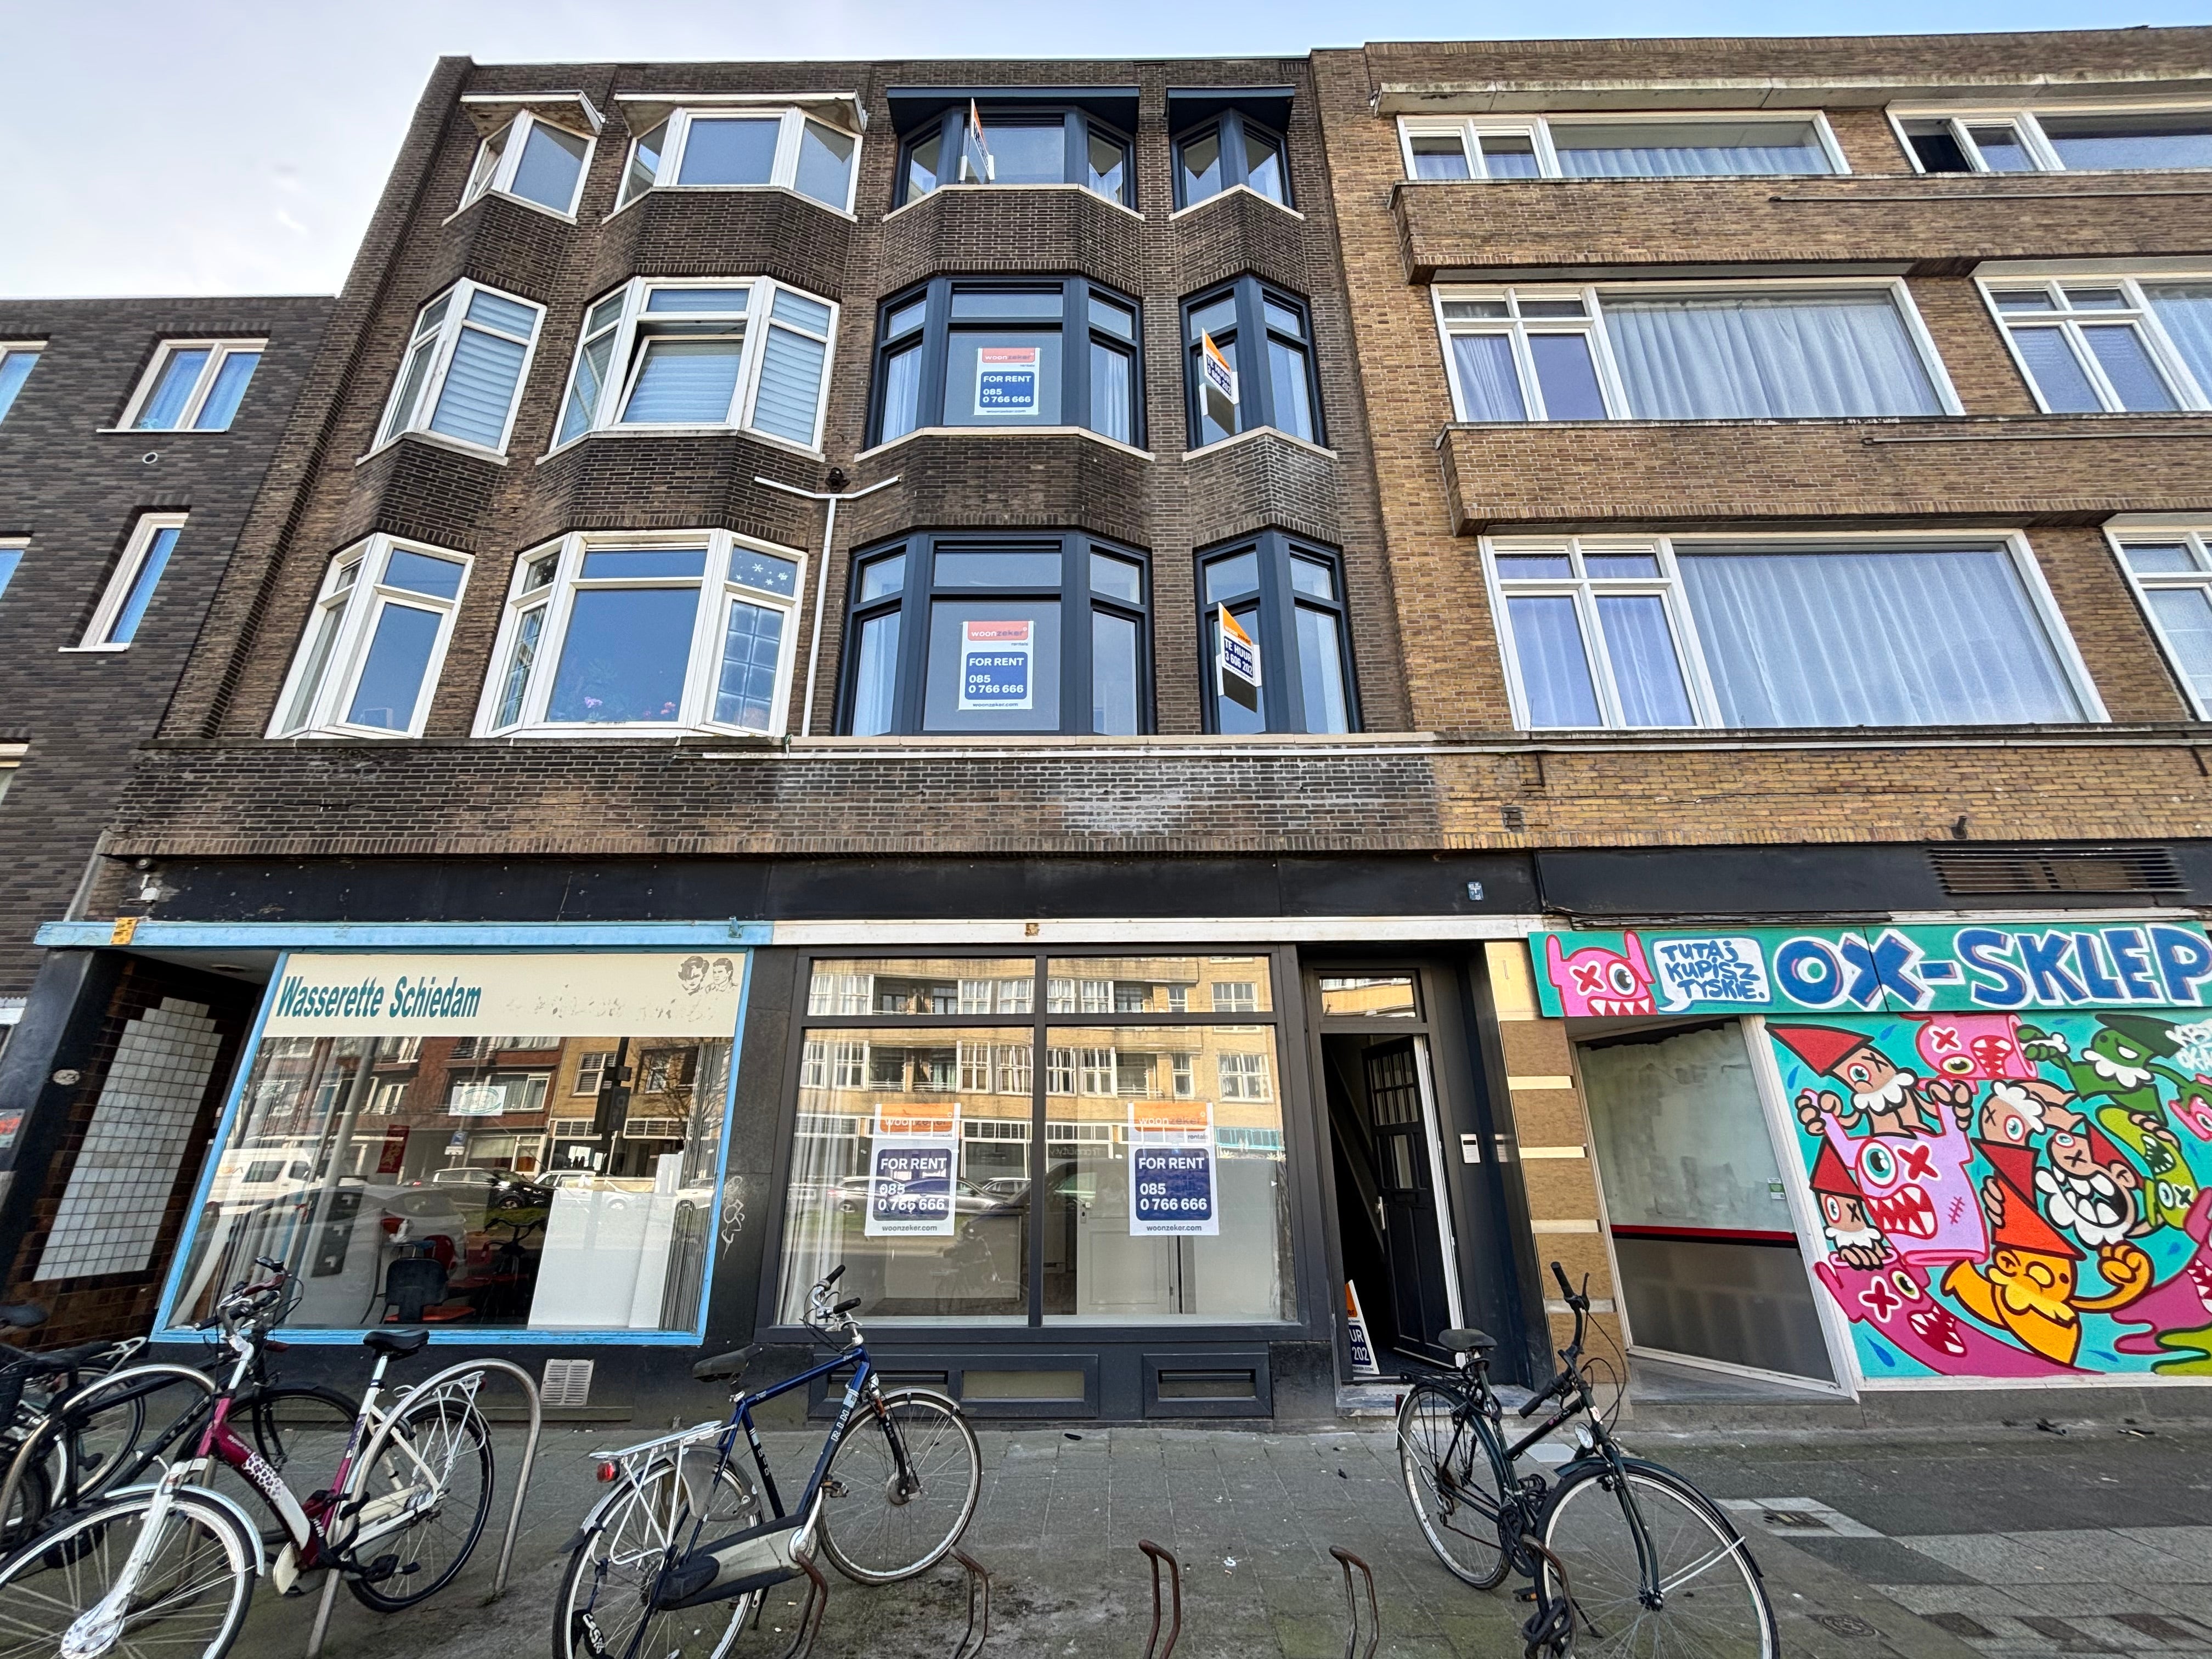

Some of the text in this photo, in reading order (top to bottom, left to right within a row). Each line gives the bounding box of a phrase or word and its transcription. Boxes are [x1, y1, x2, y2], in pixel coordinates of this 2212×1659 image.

[1207, 357, 1214, 368] TE
[1215, 363, 1231, 385] HUUR
[1224, 639, 1233, 651] TE
[1234, 645, 1252, 663] HUUR
[969, 657, 1024, 667] FOR RENT
[1225, 651, 1229, 661] 3
[1230, 654, 1241, 668] 606
[1243, 659, 1253, 675] 202
[969, 675, 991, 683] 085
[968, 685, 1024, 693] 0 766 666
[275, 976, 385, 1018] Wasserette
[389, 975, 482, 1018] Schiedam
[1139, 1117, 1201, 1125] woonzeker
[881, 1158, 947, 1170] FOR RENT
[1138, 1157, 1205, 1170] FOR RENT
[879, 1183, 906, 1196] 085
[1139, 1183, 1166, 1195] 085
[878, 1198, 945, 1211] 0 766 666
[1140, 1198, 1207, 1211] 0 766 666
[1349, 1329, 1364, 1343] UR
[1352, 1346, 1370, 1361] 202
[831, 1409, 849, 1442] RIH
